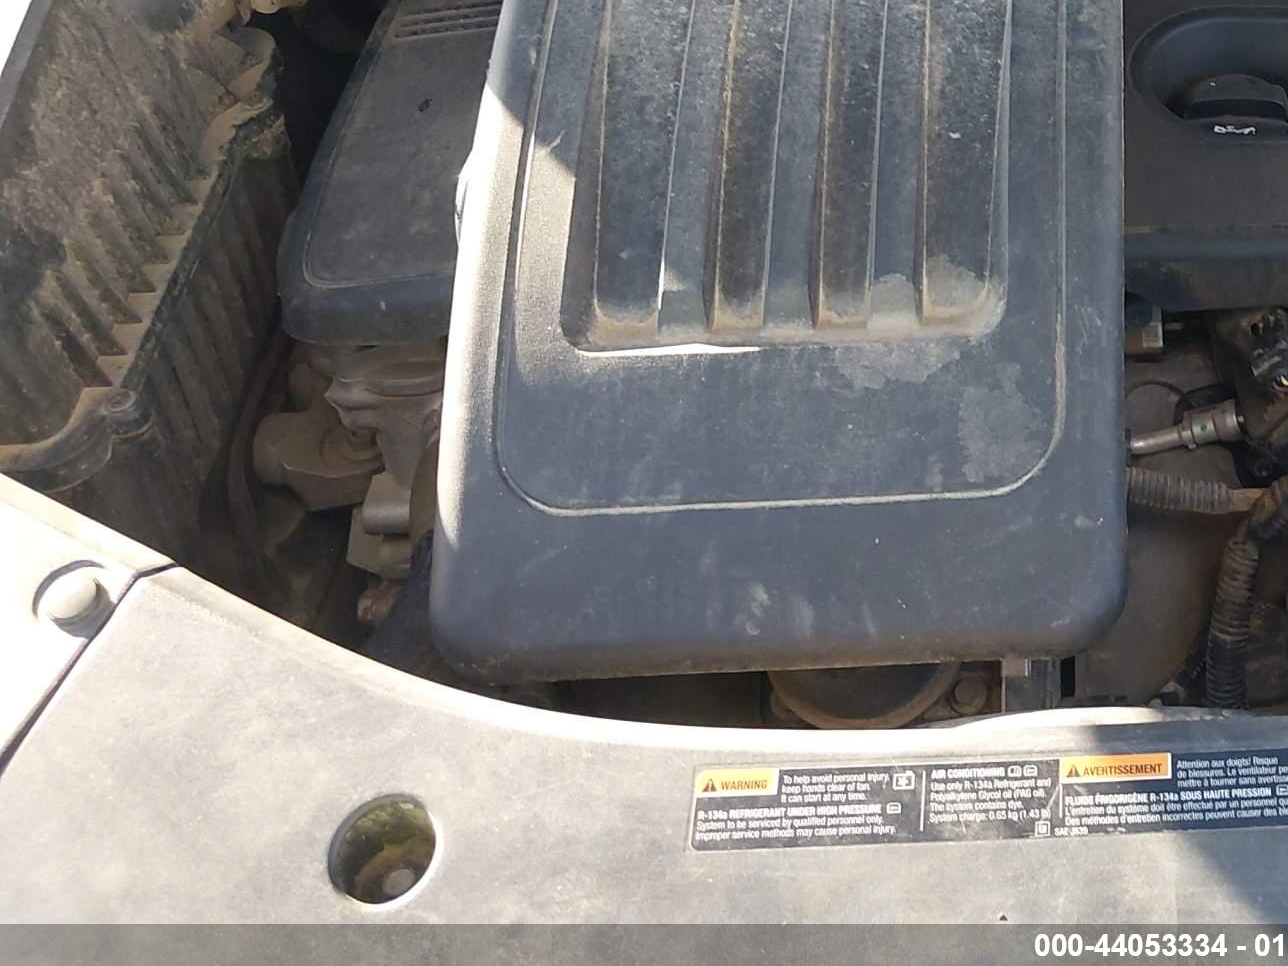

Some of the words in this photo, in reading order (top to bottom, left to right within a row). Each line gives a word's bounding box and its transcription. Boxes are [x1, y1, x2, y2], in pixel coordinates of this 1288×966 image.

[1177, 759, 1209, 769] Attention
[1211, 760, 1225, 768] aux
[1253, 756, 1278, 767] Risque
[931, 769, 946, 779] AIR
[1083, 764, 1162, 777] AVERTISSEMENT
[1238, 766, 1276, 776] ventilateur
[721, 779, 768, 791] WARNING
[833, 773, 866, 784] personal
[947, 781, 963, 792] only
[1037, 777, 1051, 788] and
[1177, 778, 1202, 788] mettre
[1210, 777, 1237, 787] tourner
[1239, 777, 1256, 785] sans
[1065, 795, 1094, 806] FLUIDE
[1150, 792, 1178, 802] R-134a
[1180, 791, 1201, 800] SOUS
[1204, 789, 1230, 799] HAUTE
[1231, 787, 1272, 798] PRESSION
[930, 803, 944, 812] The
[946, 802, 973, 813] system
[975, 801, 1007, 811] contains
[1150, 803, 1165, 812] doit
[1215, 801, 1228, 811] par
[1241, 798, 1277, 809] personnel
[1162, 811, 1203, 822] incorrectes
[1205, 810, 1235, 821] peuvent
[1237, 809, 1261, 818] causer
[1263, 808, 1277, 817] des
[697, 821, 725, 832] System
[827, 816, 865, 826] personnel
[732, 831, 760, 840] service
[761, 829, 795, 839] methods
[796, 829, 813, 838] may
[814, 828, 837, 837] cause
[839, 826, 872, 837] personal
